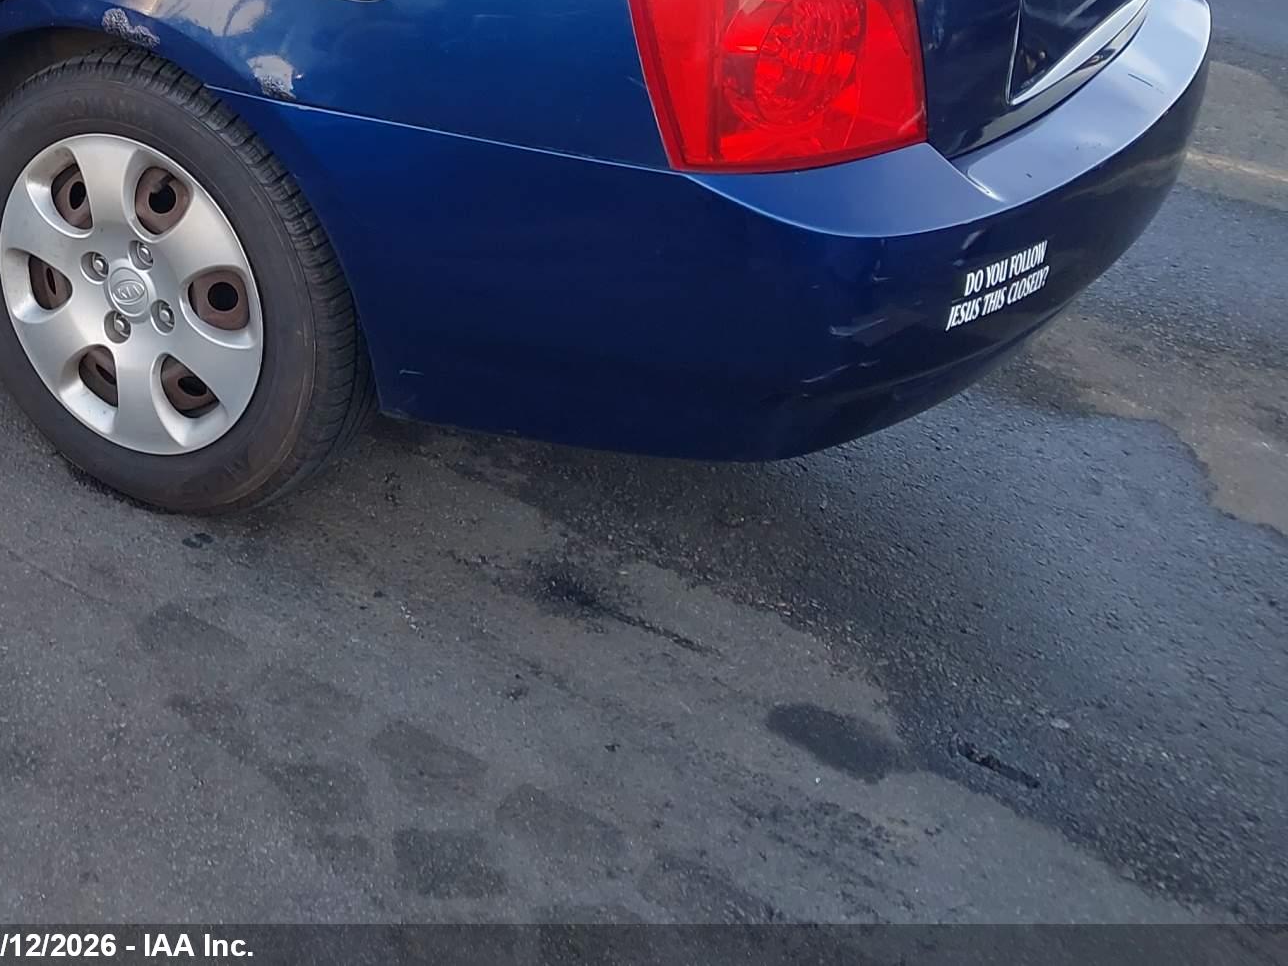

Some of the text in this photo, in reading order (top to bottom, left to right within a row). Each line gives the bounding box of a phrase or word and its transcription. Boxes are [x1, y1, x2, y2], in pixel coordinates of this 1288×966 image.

[945, 265, 1050, 331] JESUS THIS CLOSELY?
[964, 240, 1048, 297] DO YOU FOLLOW
